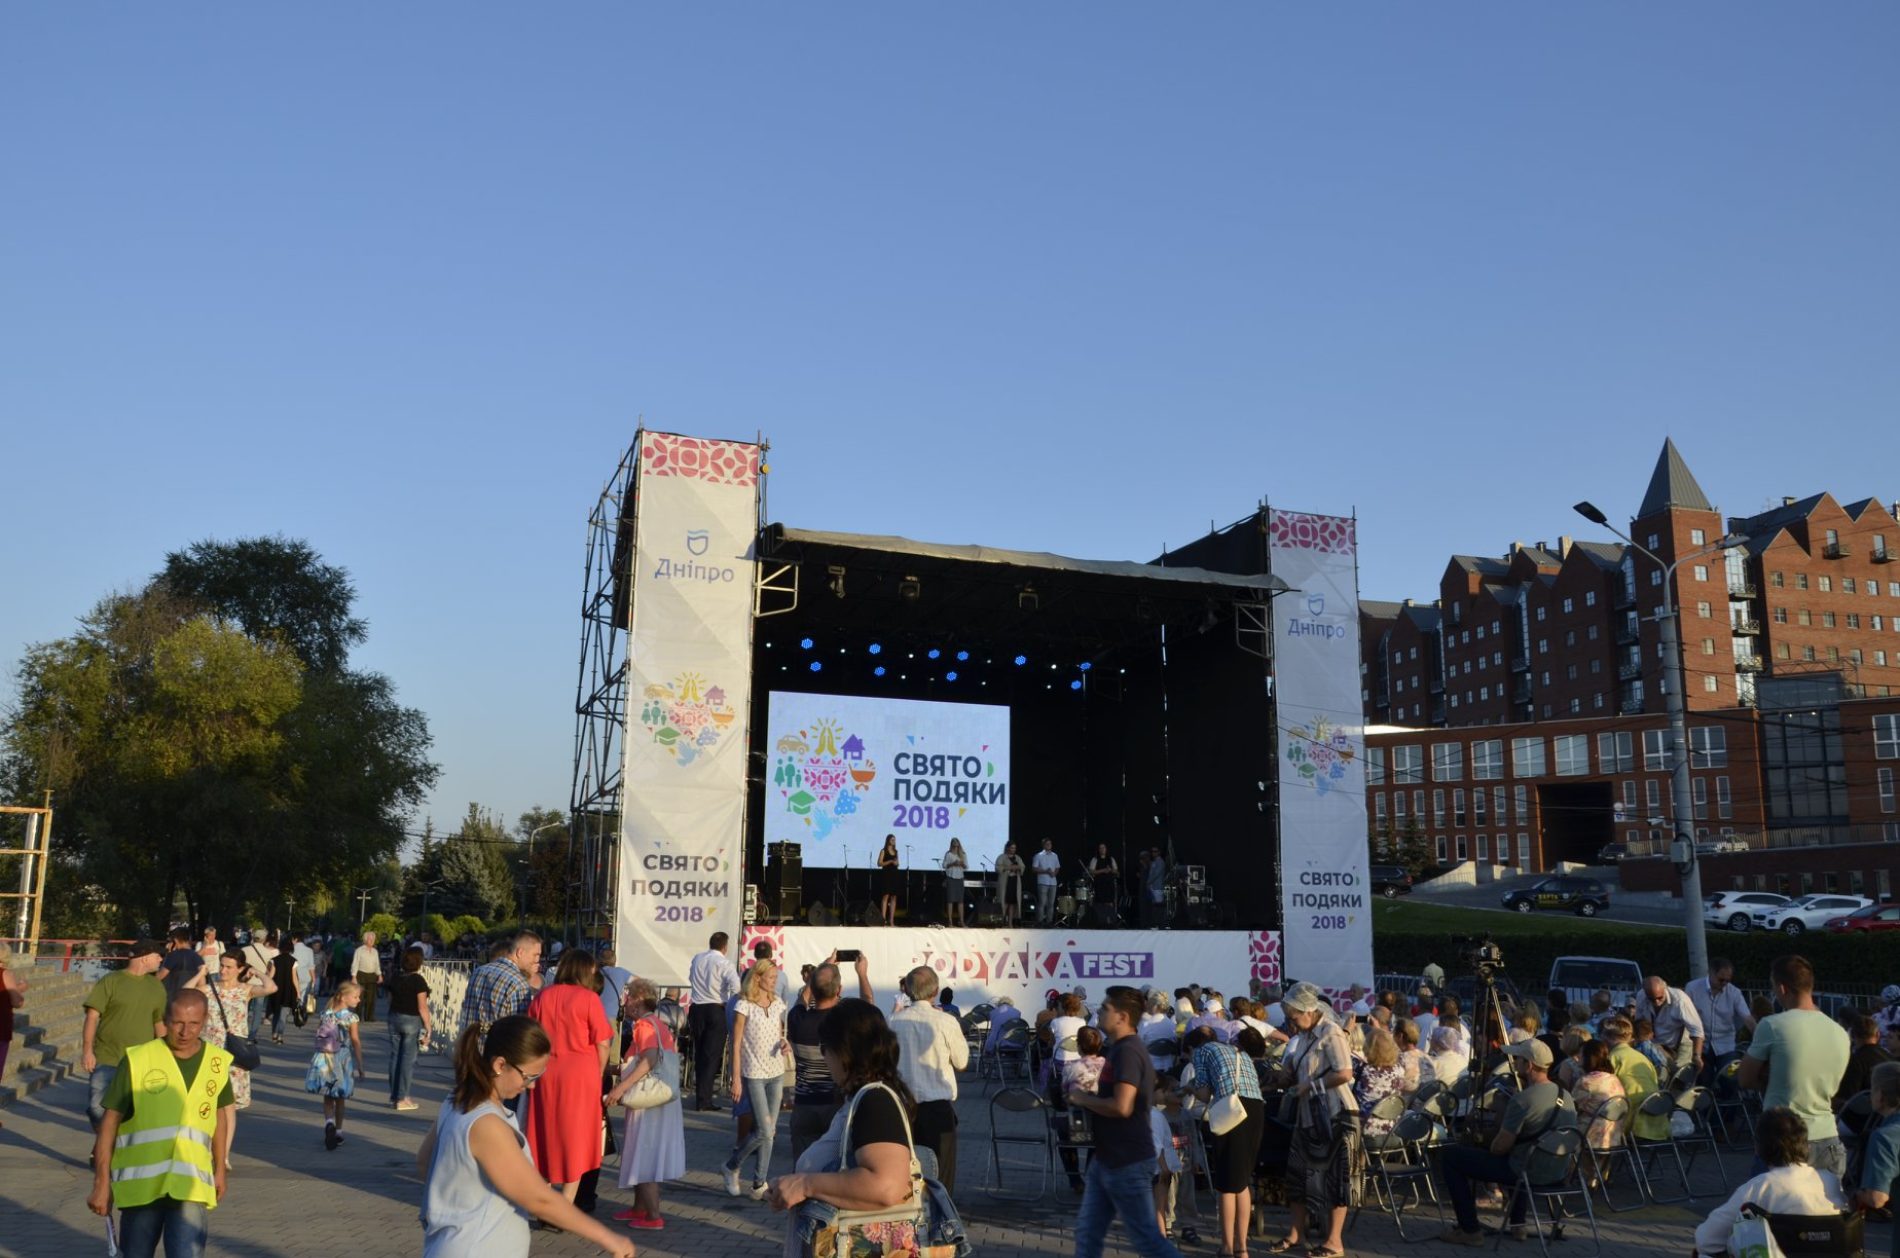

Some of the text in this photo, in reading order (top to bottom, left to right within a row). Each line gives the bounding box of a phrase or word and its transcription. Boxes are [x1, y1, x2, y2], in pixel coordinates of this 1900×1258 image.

[654, 558, 735, 584] Дніпро
[1288, 618, 1345, 639] Дніпро
[893, 752, 982, 778] СВЯТО
[893, 778, 1006, 805] ПОДЯКИ
[892, 804, 950, 829] 2018
[643, 854, 719, 872] СВЯТО
[1300, 871, 1354, 886] СВЯТО
[631, 879, 729, 899] ПОДЯКИ
[1292, 893, 1362, 910] ПОДЯКИ
[654, 905, 703, 922] 2018
[1311, 915, 1347, 930] 2018
